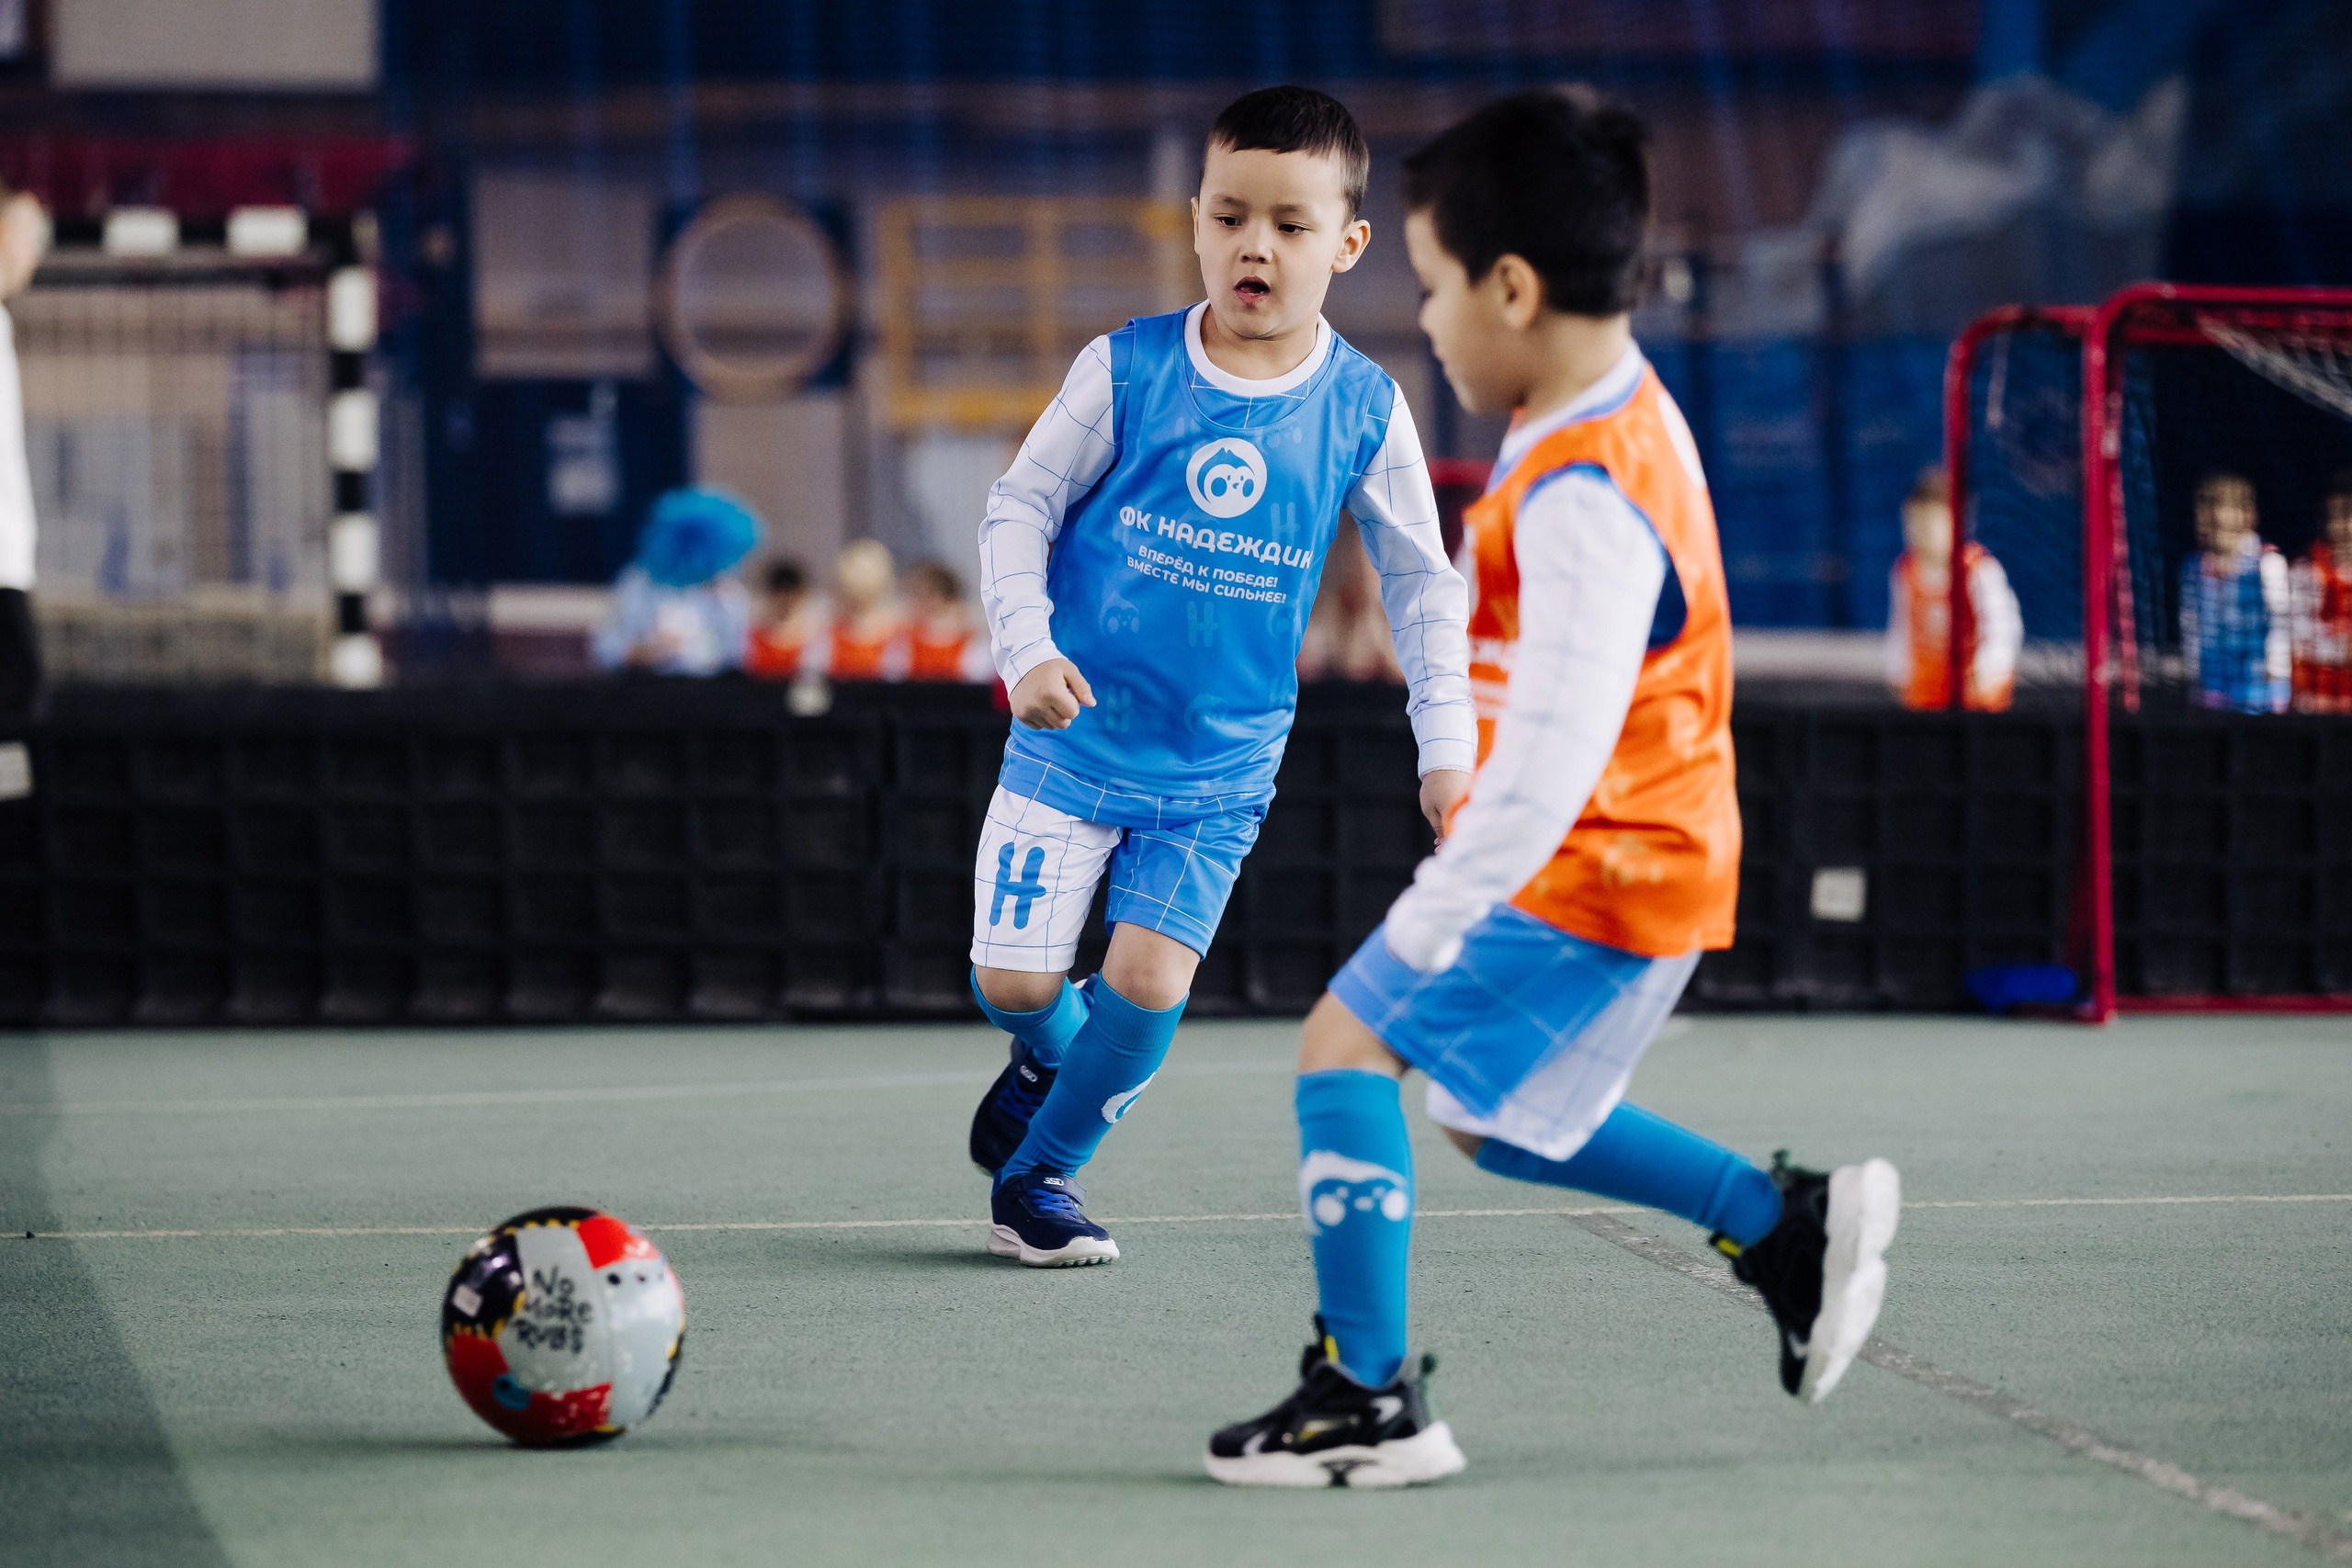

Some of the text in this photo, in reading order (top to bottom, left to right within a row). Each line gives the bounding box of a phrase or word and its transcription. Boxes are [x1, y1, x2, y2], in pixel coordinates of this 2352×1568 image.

[1119, 505, 1152, 532] ФК
[1126, 555, 1287, 604] ВМЕСТЕ МЫ СИЛЬНЕЕ!
[1138, 545, 1279, 589] ВПЕРЁД К ПОБЕДЕ!
[532, 1264, 576, 1296] No
